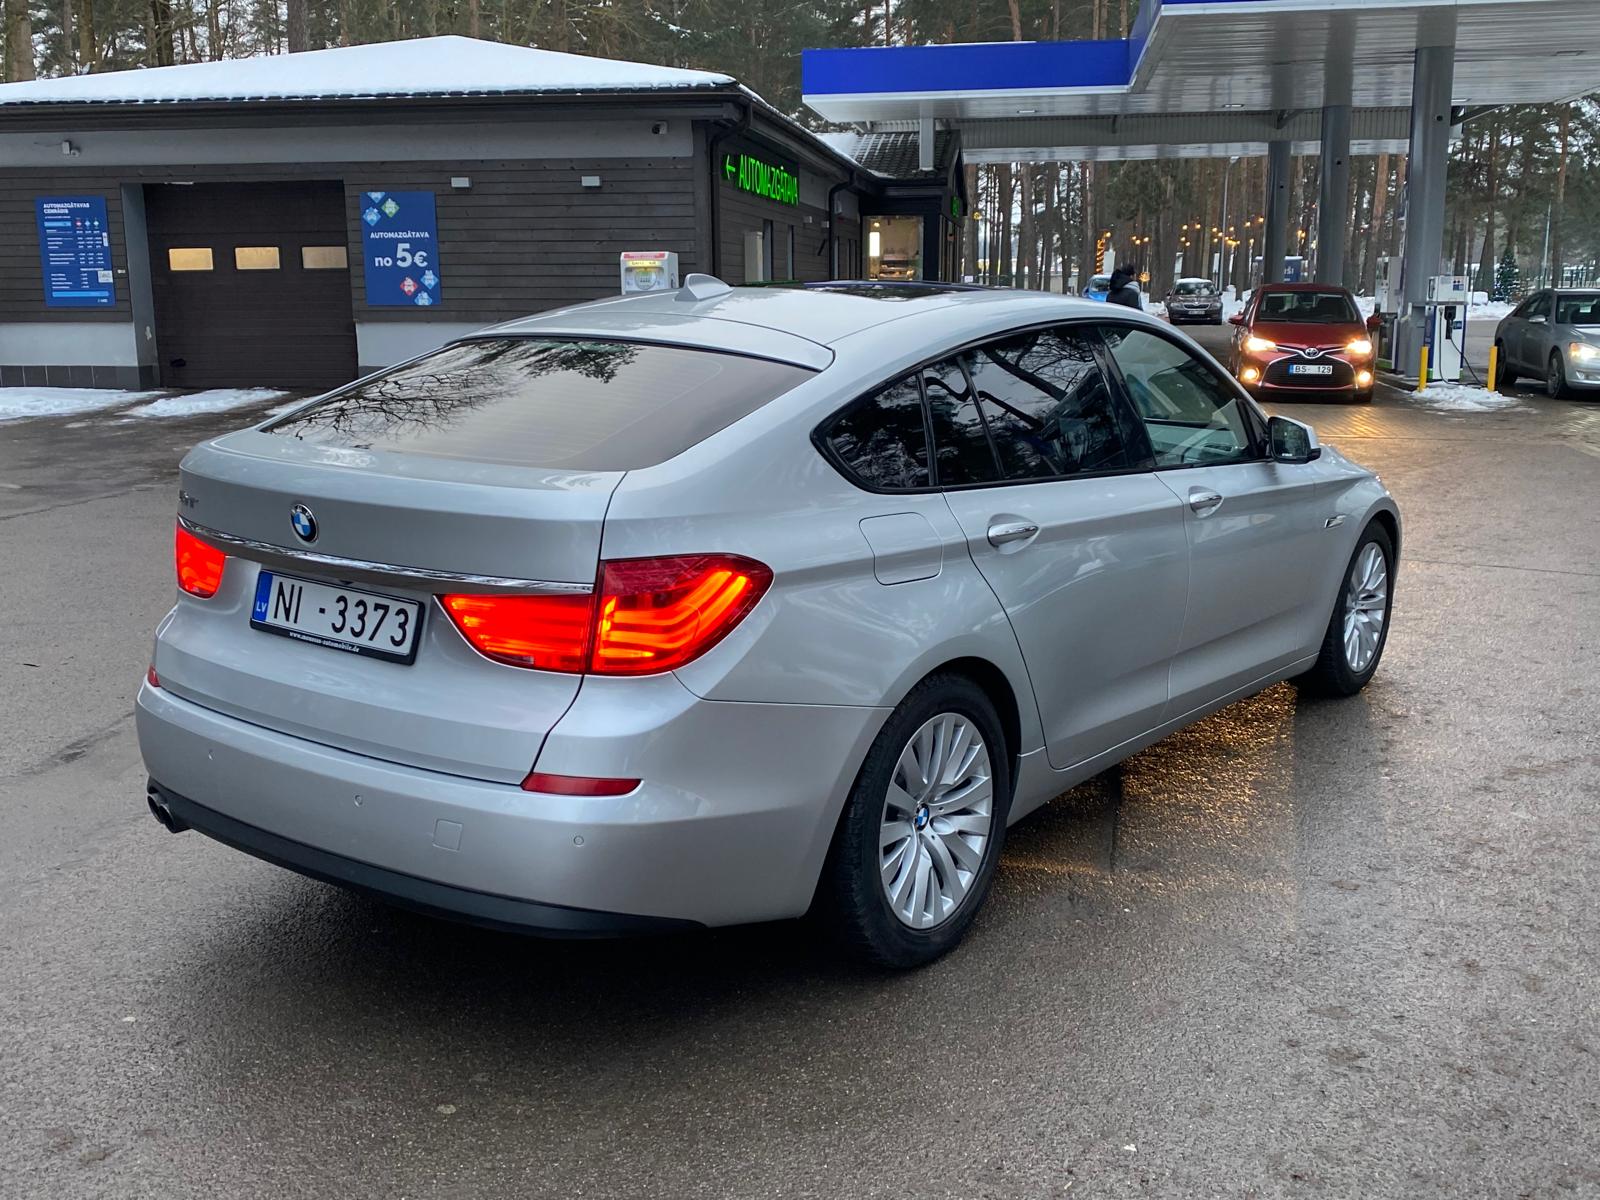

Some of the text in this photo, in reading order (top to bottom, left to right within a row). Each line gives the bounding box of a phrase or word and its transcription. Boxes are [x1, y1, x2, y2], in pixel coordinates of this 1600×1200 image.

[738, 153, 799, 207] AUTOMAZGĀTAVA
[370, 230, 430, 239] AUTOMAZGĀTAVA
[374, 243, 428, 268] no 5€
[255, 600, 268, 613] LV
